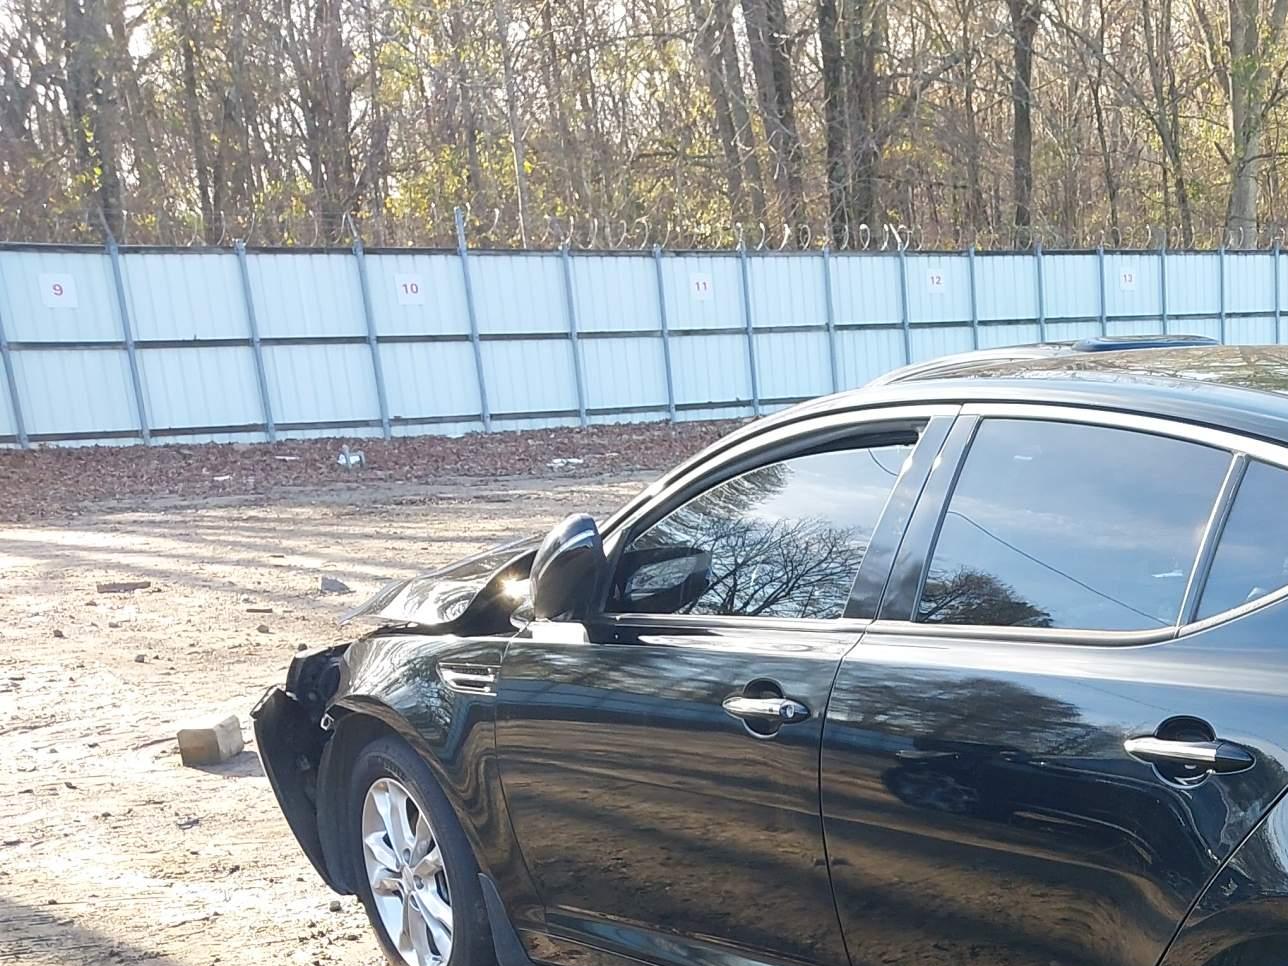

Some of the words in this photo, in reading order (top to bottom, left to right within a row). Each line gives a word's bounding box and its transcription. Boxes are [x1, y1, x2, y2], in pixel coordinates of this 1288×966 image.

[930, 275, 942, 285] 12
[52, 283, 64, 297] 9
[402, 283, 419, 295] 10
[695, 281, 708, 291] 11
